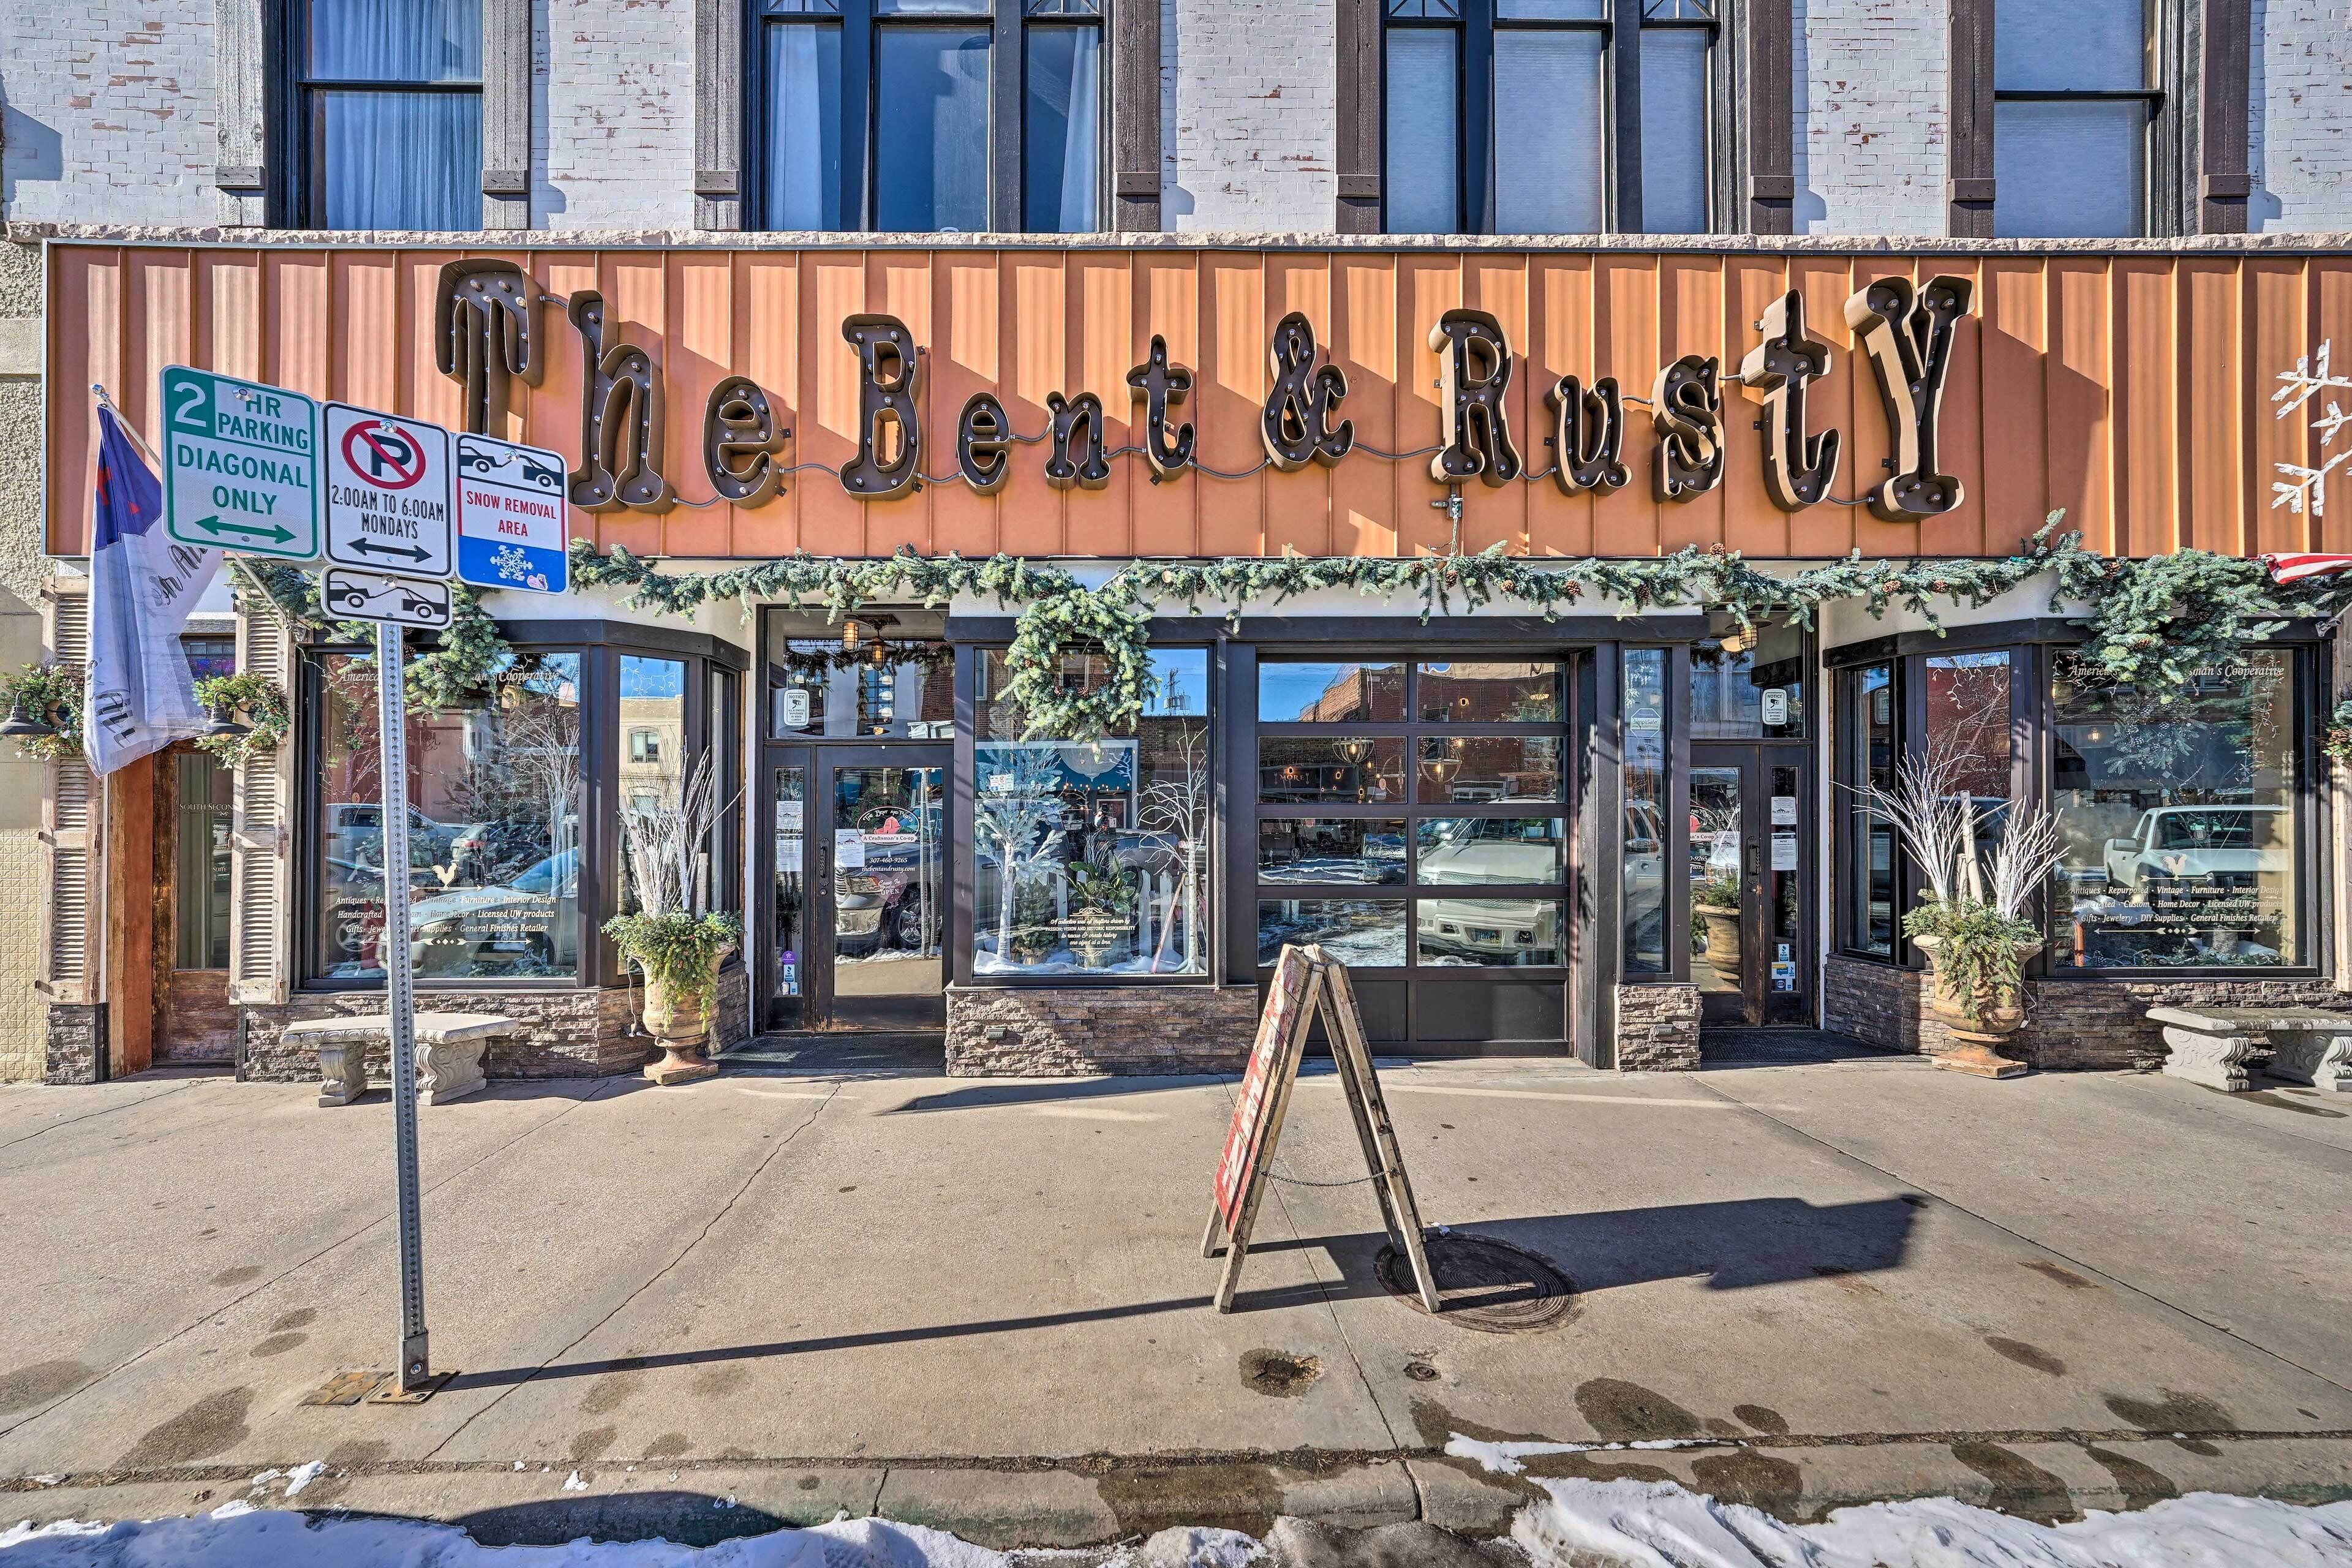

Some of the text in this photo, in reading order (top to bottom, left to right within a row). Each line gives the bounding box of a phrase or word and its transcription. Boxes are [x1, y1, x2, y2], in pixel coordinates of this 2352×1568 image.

[434, 257, 783, 513] The
[839, 313, 1196, 501] Bent
[1261, 311, 1354, 472] &
[174, 382, 281, 427] 2 HR
[218, 412, 308, 450] PARKING
[177, 443, 308, 489] DIAGONAL
[213, 485, 277, 515] ONLY
[331, 484, 444, 522] 2:00AM TO 6:00AM
[466, 490, 557, 519] SNOW REMOVAL
[361, 512, 418, 540] MONDAYS
[497, 519, 529, 537] AREA
[499, 671, 560, 685] Cooperative
[2225, 665, 2285, 679] Cooperative
[862, 865, 916, 874] thebentandrusty.com
[2070, 886, 2101, 895] Antiques
[2157, 886, 2184, 895] Vintage
[2190, 886, 2225, 894] Furniture
[2232, 886, 2260, 894] Interior
[2260, 886, 2283, 895] Design
[336, 895, 368, 906] Antiques
[532, 895, 557, 905] Design
[2123, 900, 2150, 908] Custom
[2157, 900, 2178, 908] Home
[2179, 900, 2200, 908] Decor
[2207, 900, 2239, 908] Licensed
[2239, 900, 2251, 908] UW
[337, 910, 383, 919] Handcrafted
[477, 910, 508, 918] Licensed
[522, 910, 555, 919] products
[2081, 914, 2098, 924] Gifts
[2102, 914, 2133, 923] Jewelery
[2154, 914, 2184, 924] Supplies
[2191, 913, 2220, 922] General
[2219, 913, 2248, 922] Finishes
[2248, 913, 2277, 922] Retailer
[346, 924, 364, 933] Gifts
[422, 924, 452, 934] Supplies
[520, 924, 549, 932] Retailer
